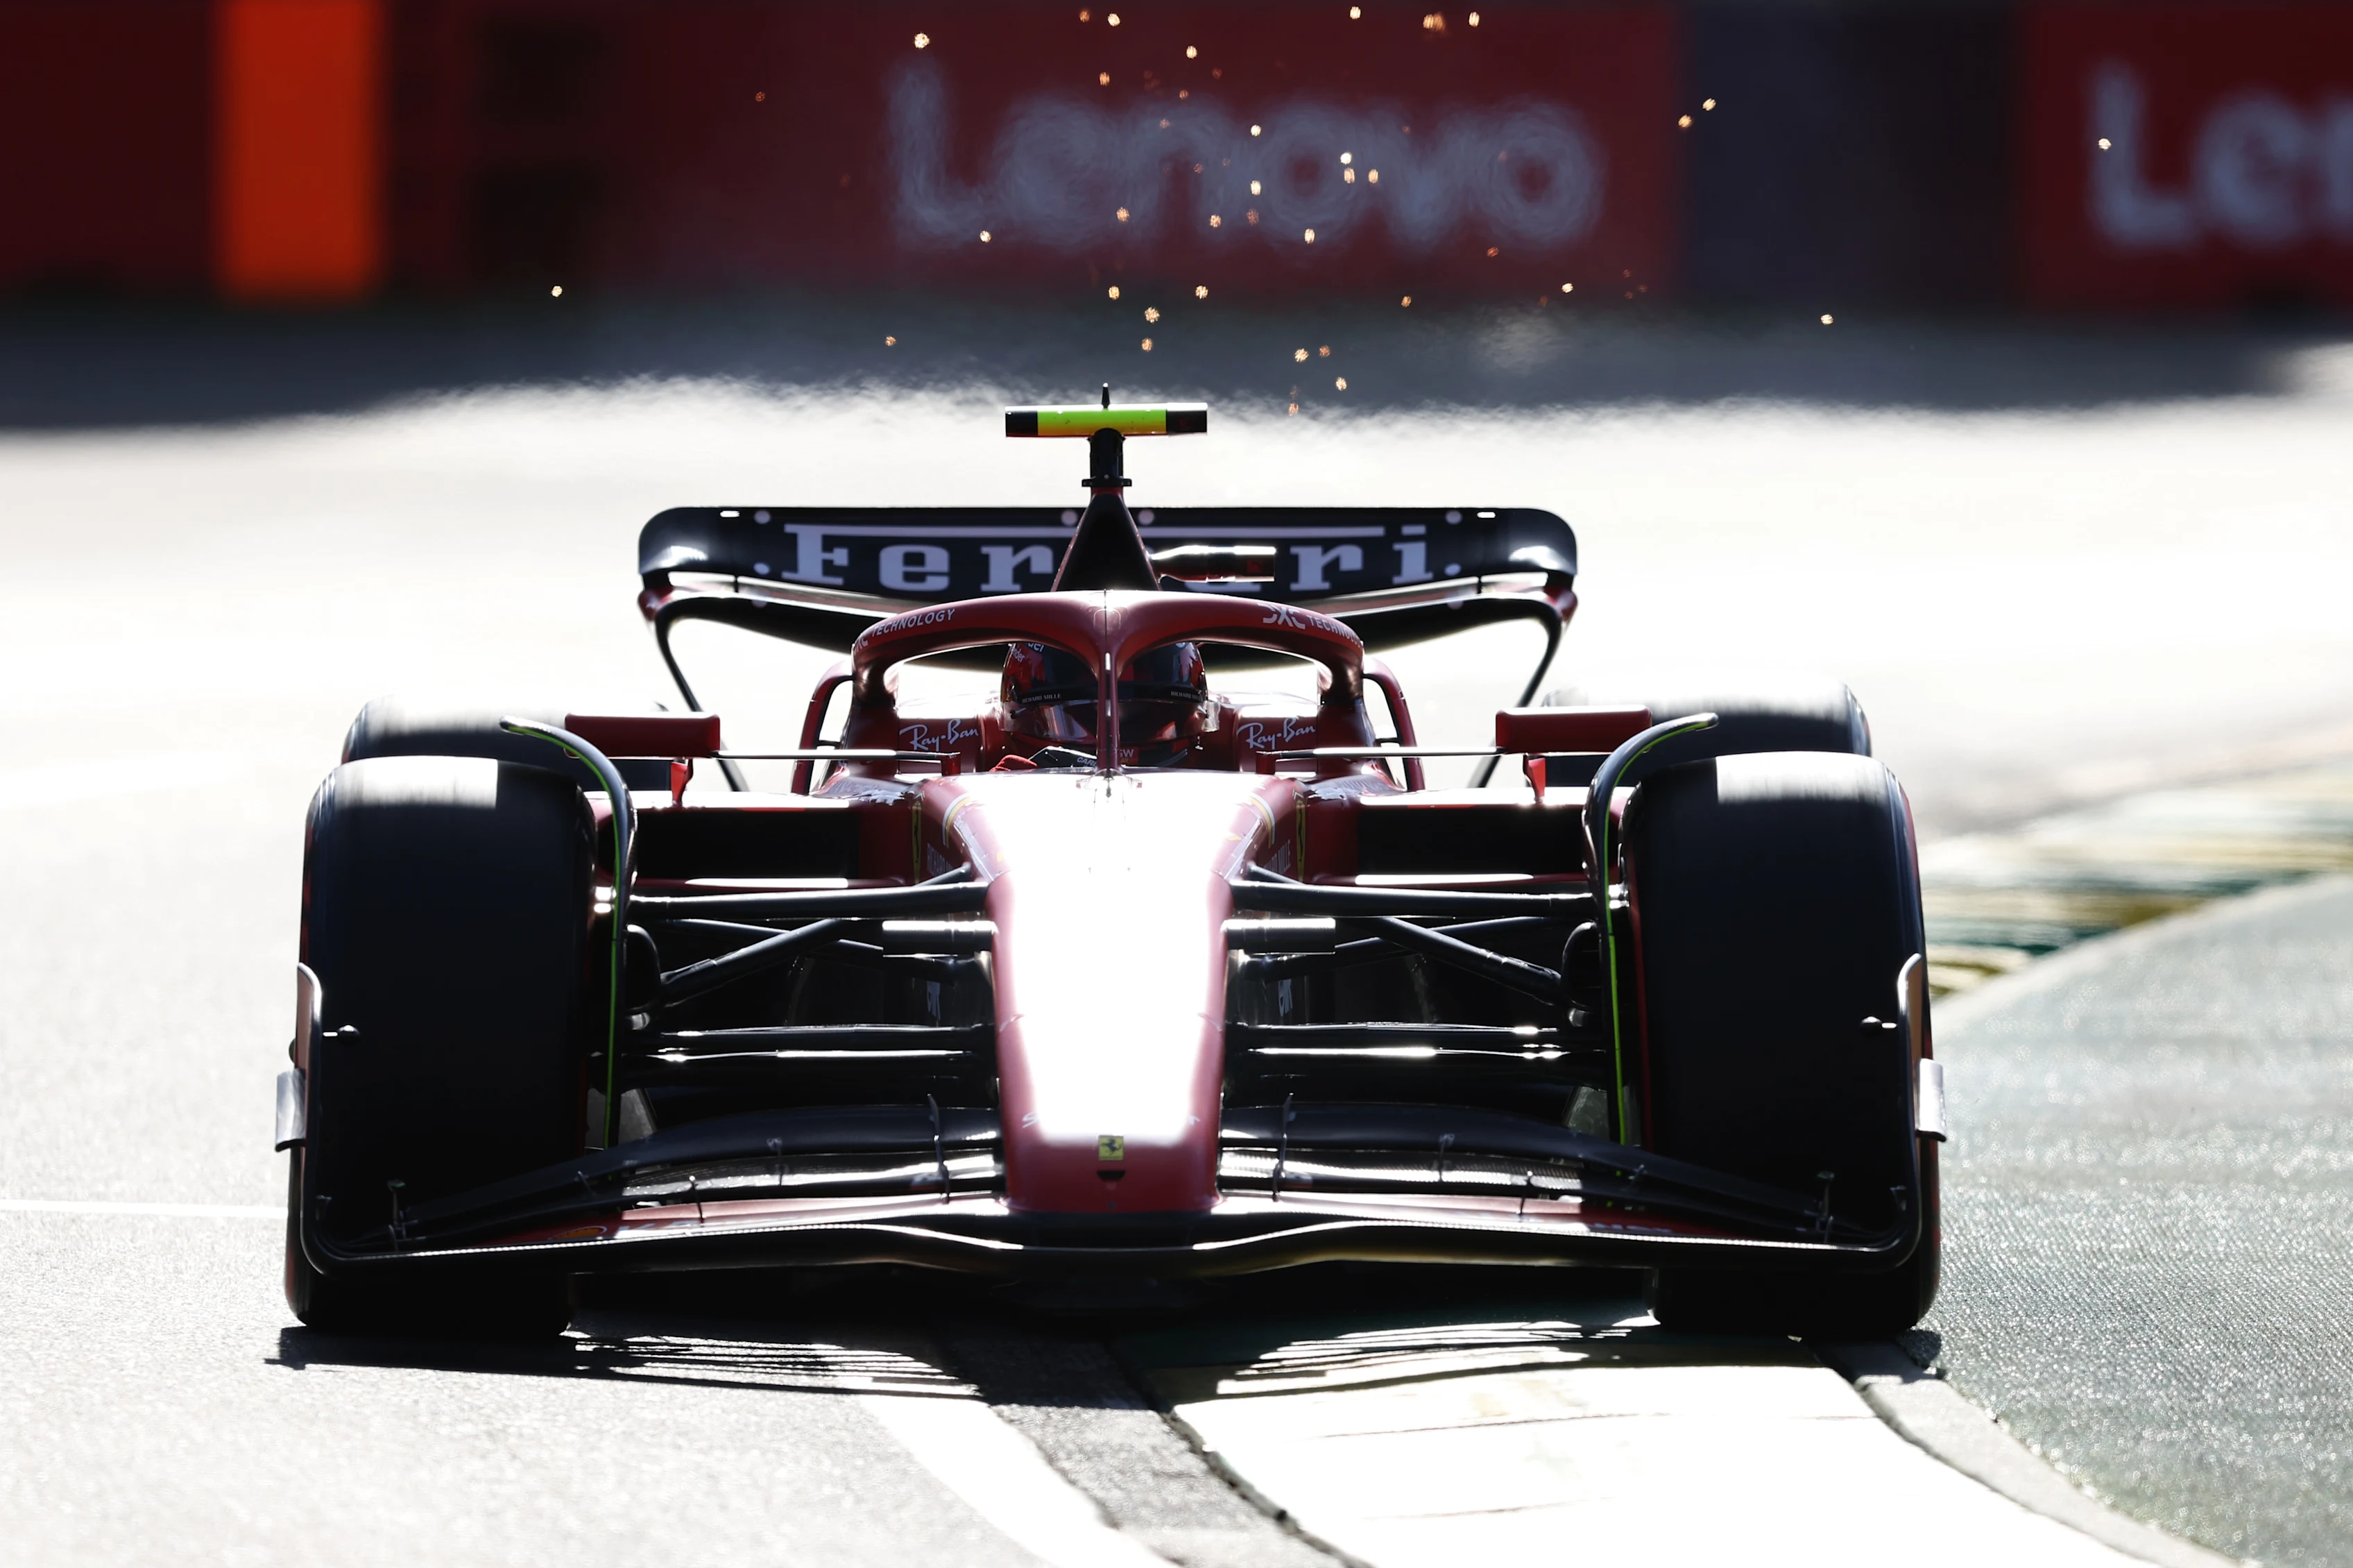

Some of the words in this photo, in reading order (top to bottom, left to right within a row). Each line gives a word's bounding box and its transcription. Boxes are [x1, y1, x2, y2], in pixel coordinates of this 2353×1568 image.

[888, 60, 1604, 244] Lenovo
[2089, 62, 2352, 247] Le
[782, 523, 1433, 592] Ferri
[872, 609, 955, 637] TECHNOLOGY
[1021, 695, 1043, 704] RICHARD
